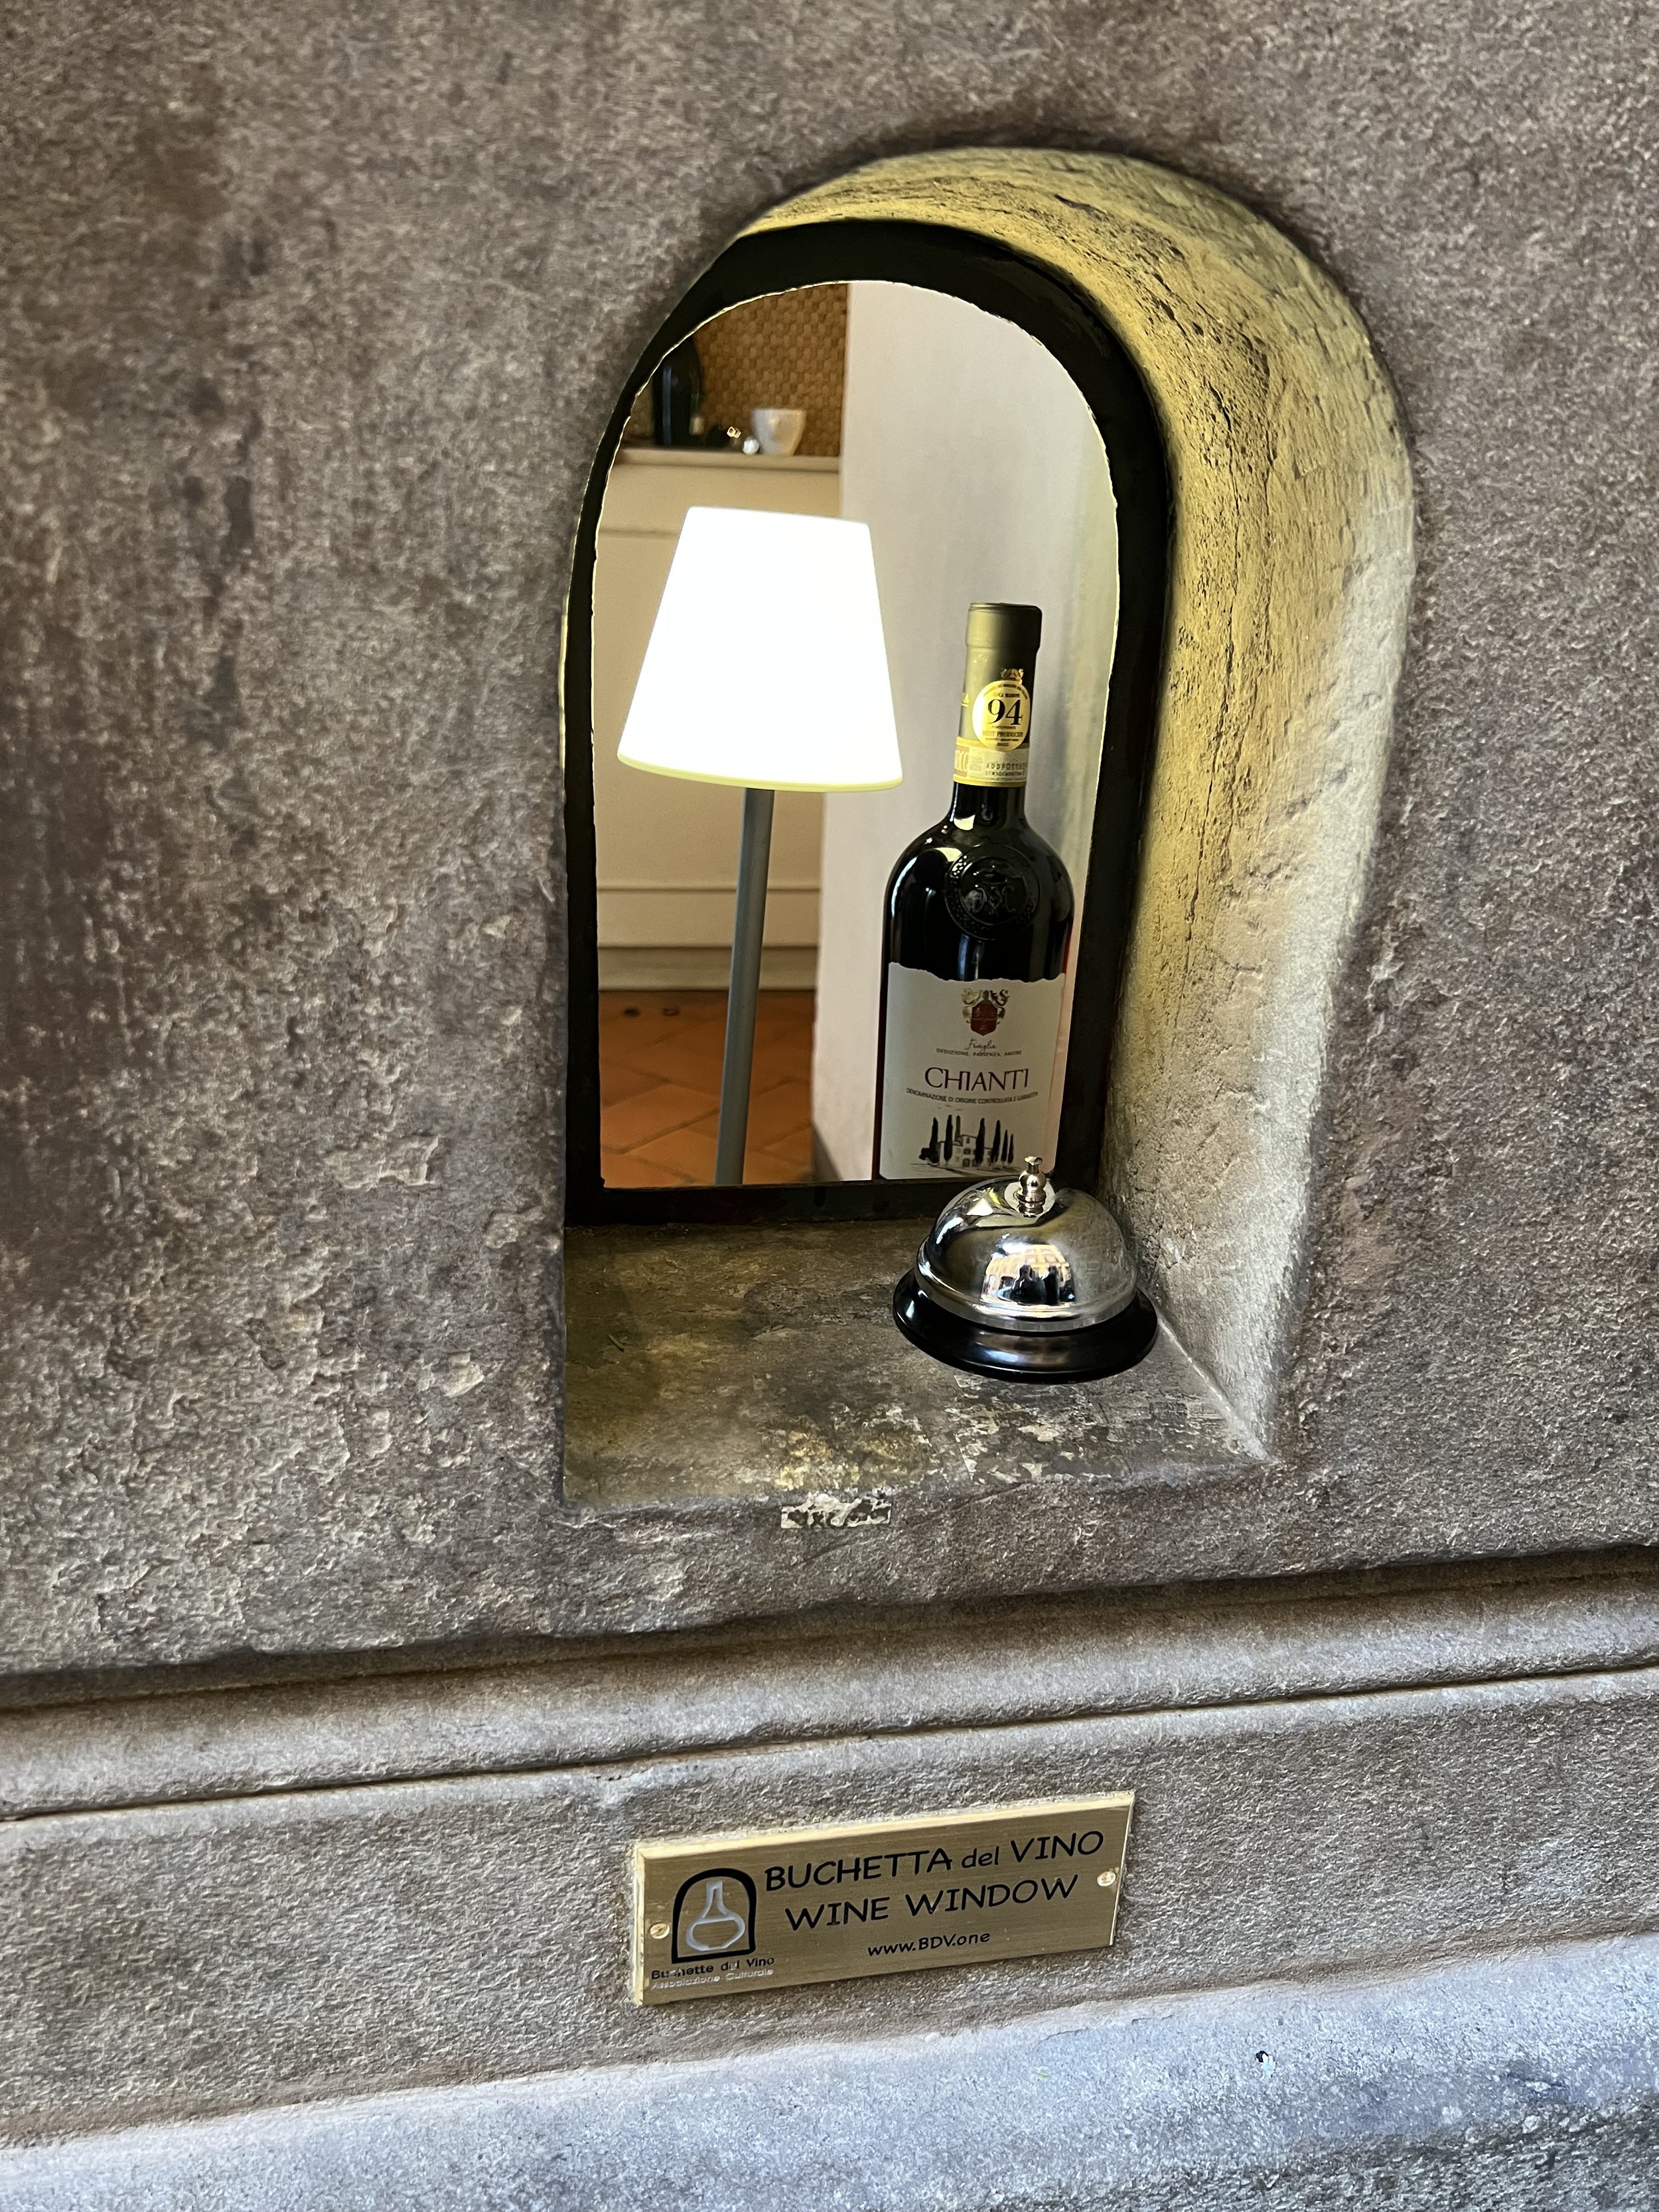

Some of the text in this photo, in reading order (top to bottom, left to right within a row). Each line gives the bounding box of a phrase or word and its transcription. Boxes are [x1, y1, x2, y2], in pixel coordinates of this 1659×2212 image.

[987, 699, 1023, 726] 94
[924, 1067, 1029, 1091] CHIANTI
[764, 1830, 1104, 1891] BUCHETTA del VINO
[784, 1874, 1078, 1931] WINE WINDOW
[867, 1933, 990, 1956] www.BDV.one
[747, 1956, 774, 1968] Vino
[725, 1968, 774, 1981] Culturale
